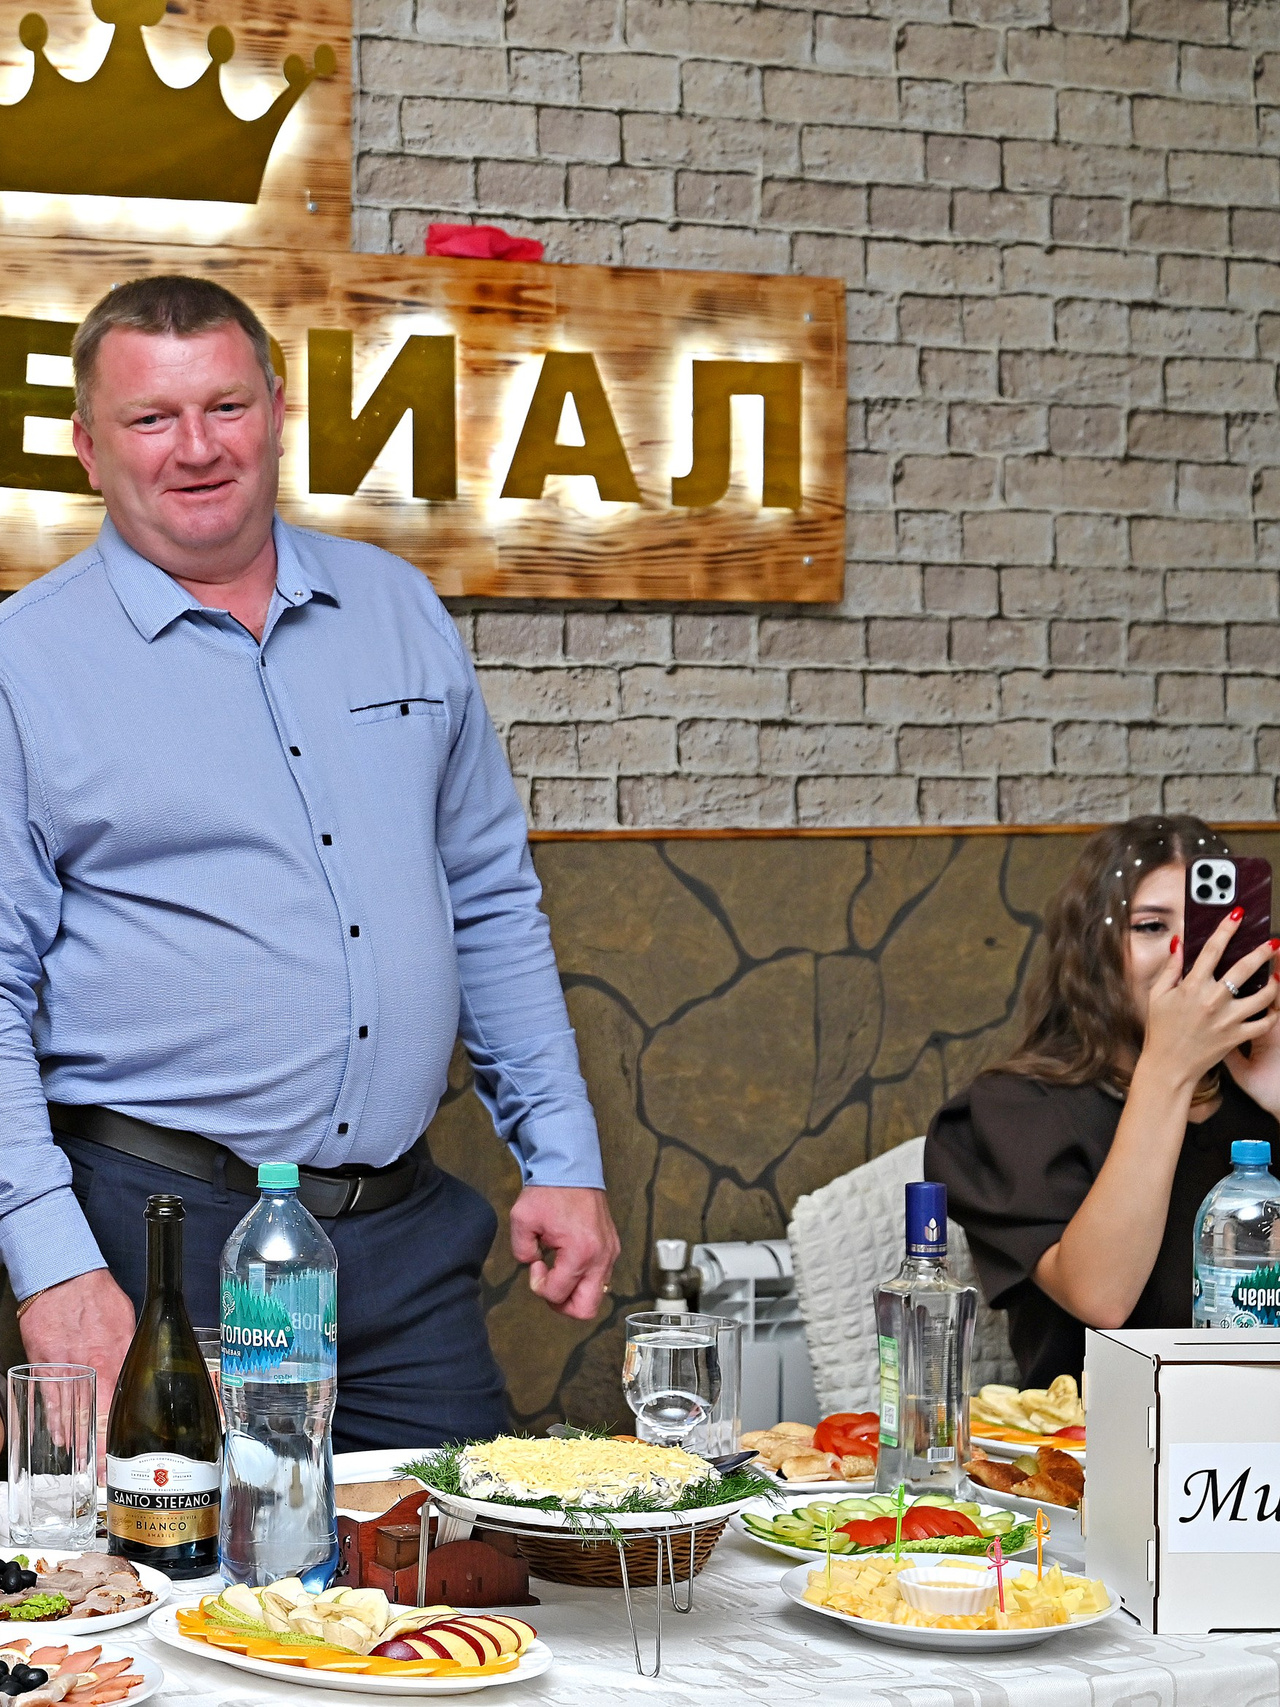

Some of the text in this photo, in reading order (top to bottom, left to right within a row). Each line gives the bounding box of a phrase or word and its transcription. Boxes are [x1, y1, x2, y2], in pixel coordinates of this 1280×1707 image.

[221, 1322, 288, 1348] ГОЛОВКА
[114, 1490, 211, 1509] SANTO STEFANO
[136, 1520, 187, 1531] BIANCO
